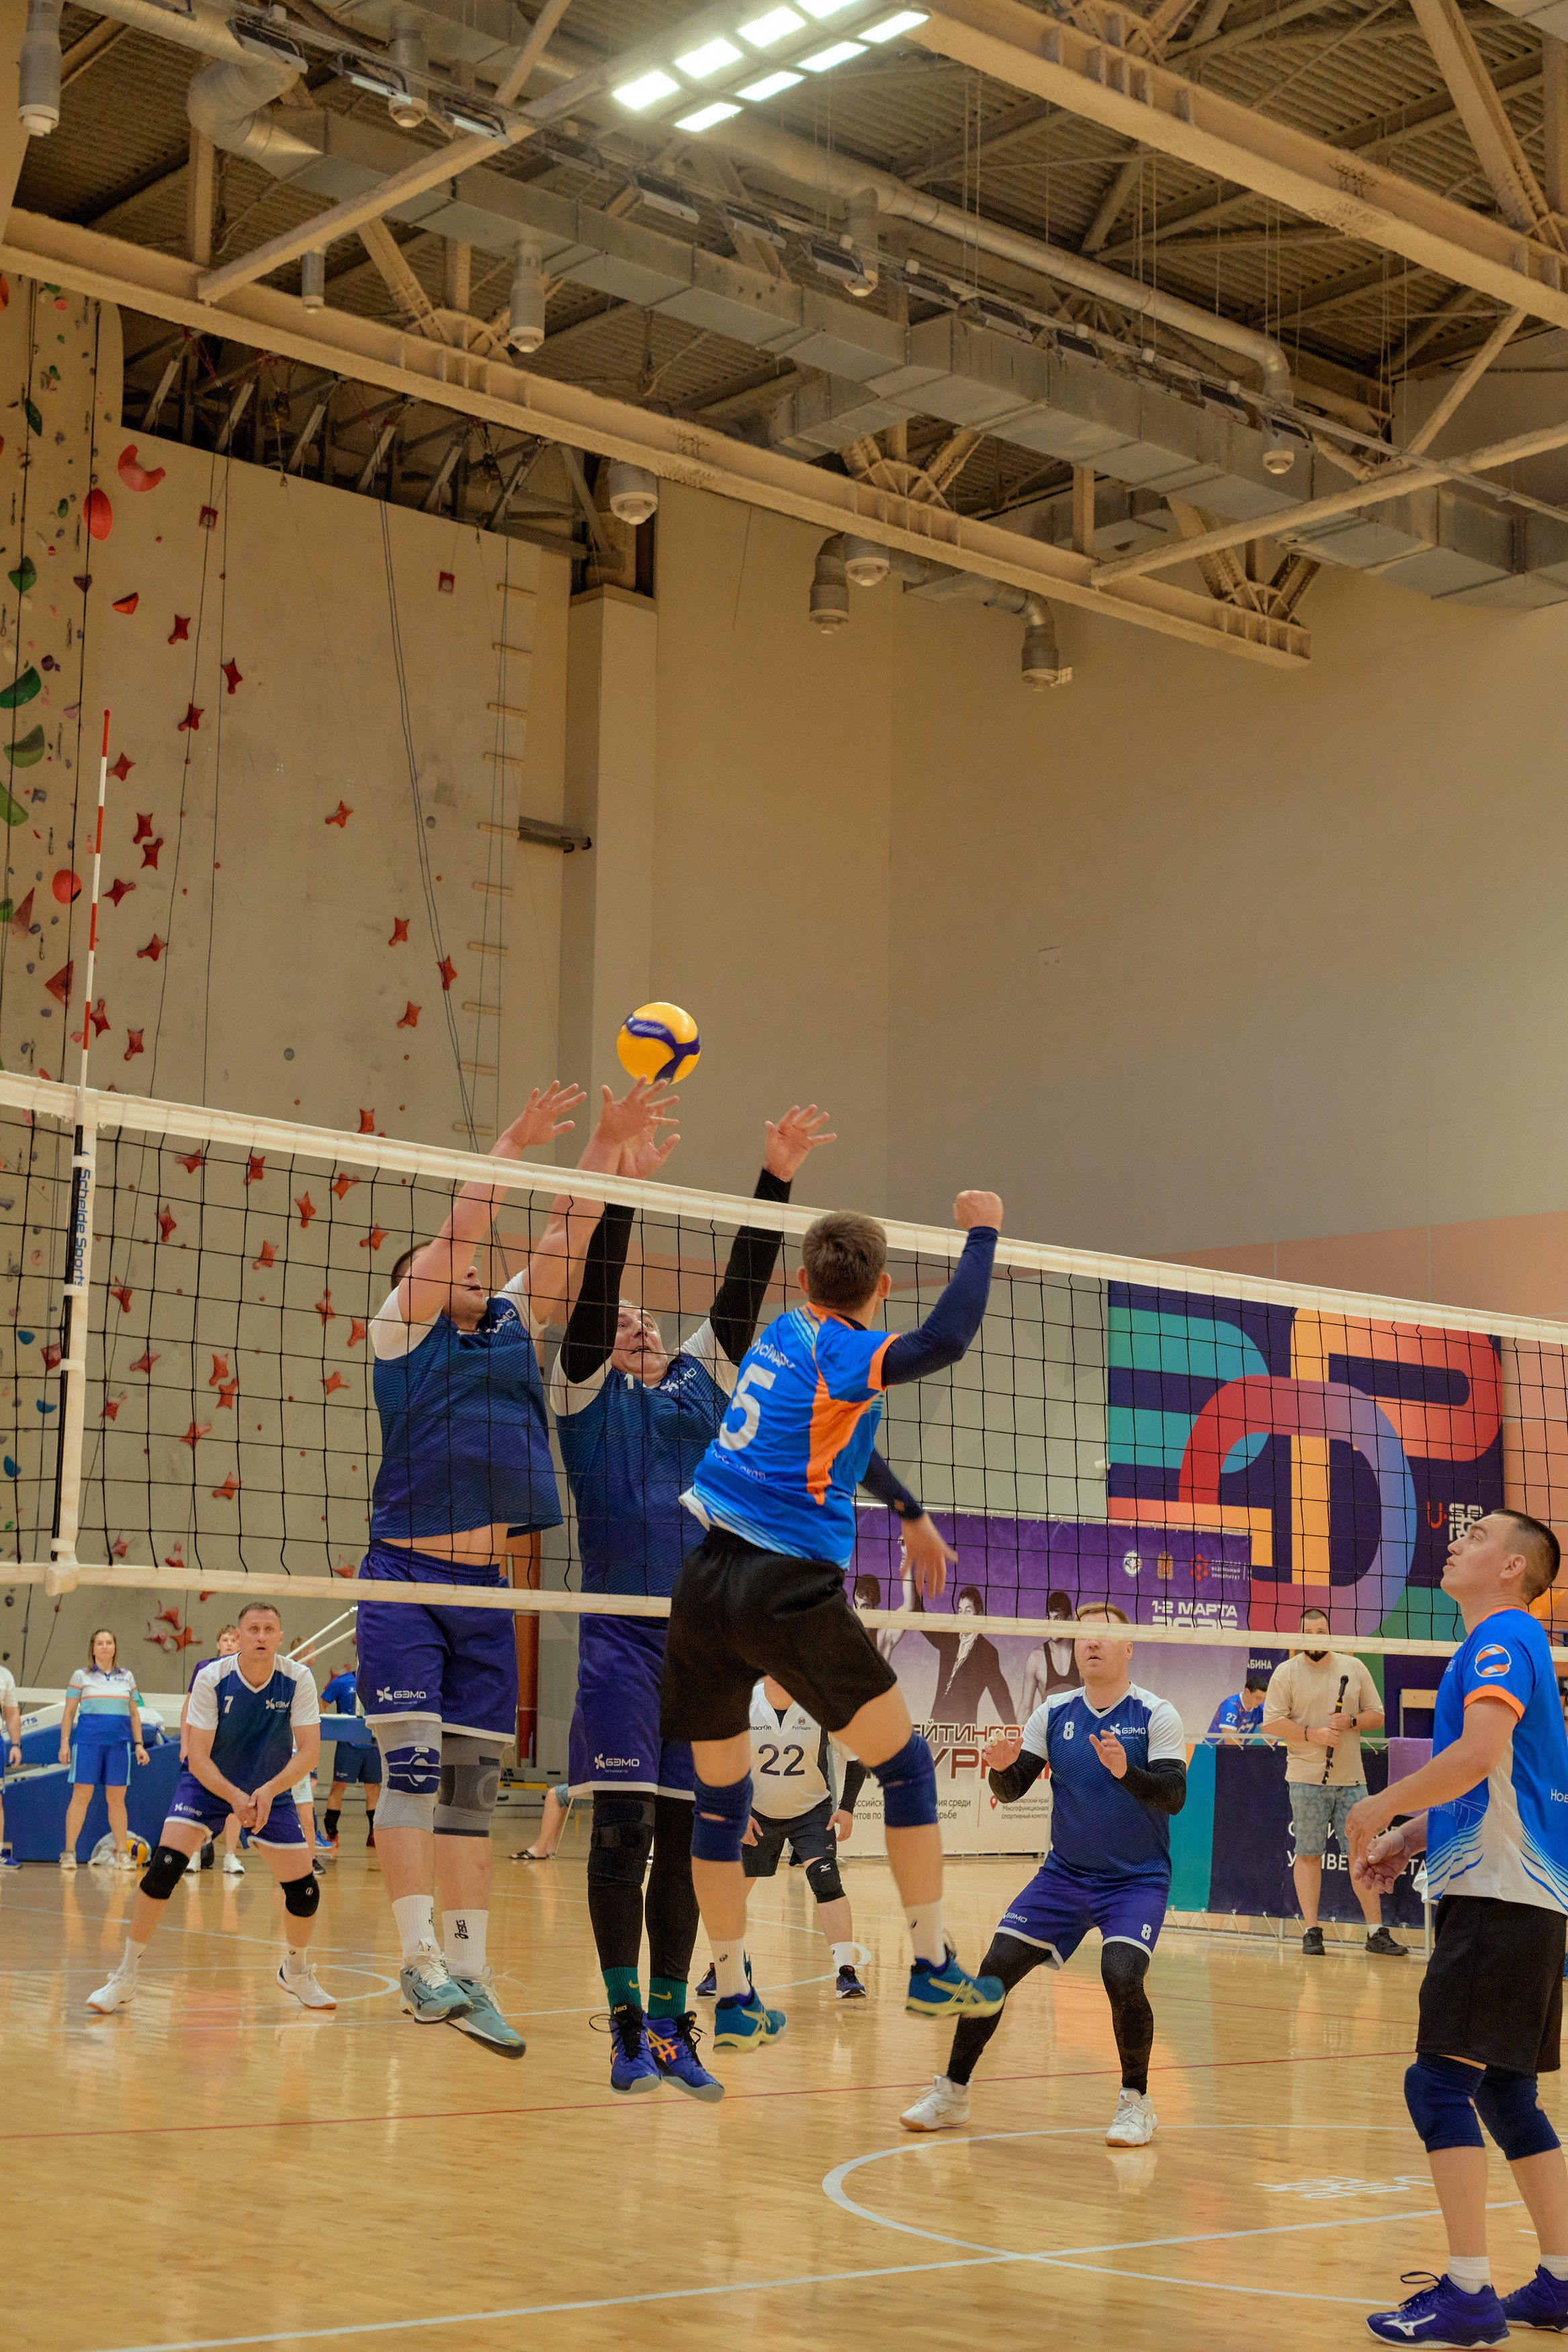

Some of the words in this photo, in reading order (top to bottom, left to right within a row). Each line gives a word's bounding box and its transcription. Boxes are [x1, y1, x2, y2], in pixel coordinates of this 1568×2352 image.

[76, 1169, 91, 1233] Schelde
[719, 1362, 777, 1452] 5
[1178, 1602, 1237, 1618] МАРТА
[224, 1695, 234, 1714] 7
[1226, 1712, 1237, 1723] 27
[1063, 1721, 1075, 1740] 8
[758, 1744, 805, 1776] 22
[949, 1800, 971, 1810] среди
[1141, 1923, 1152, 1941] 8
